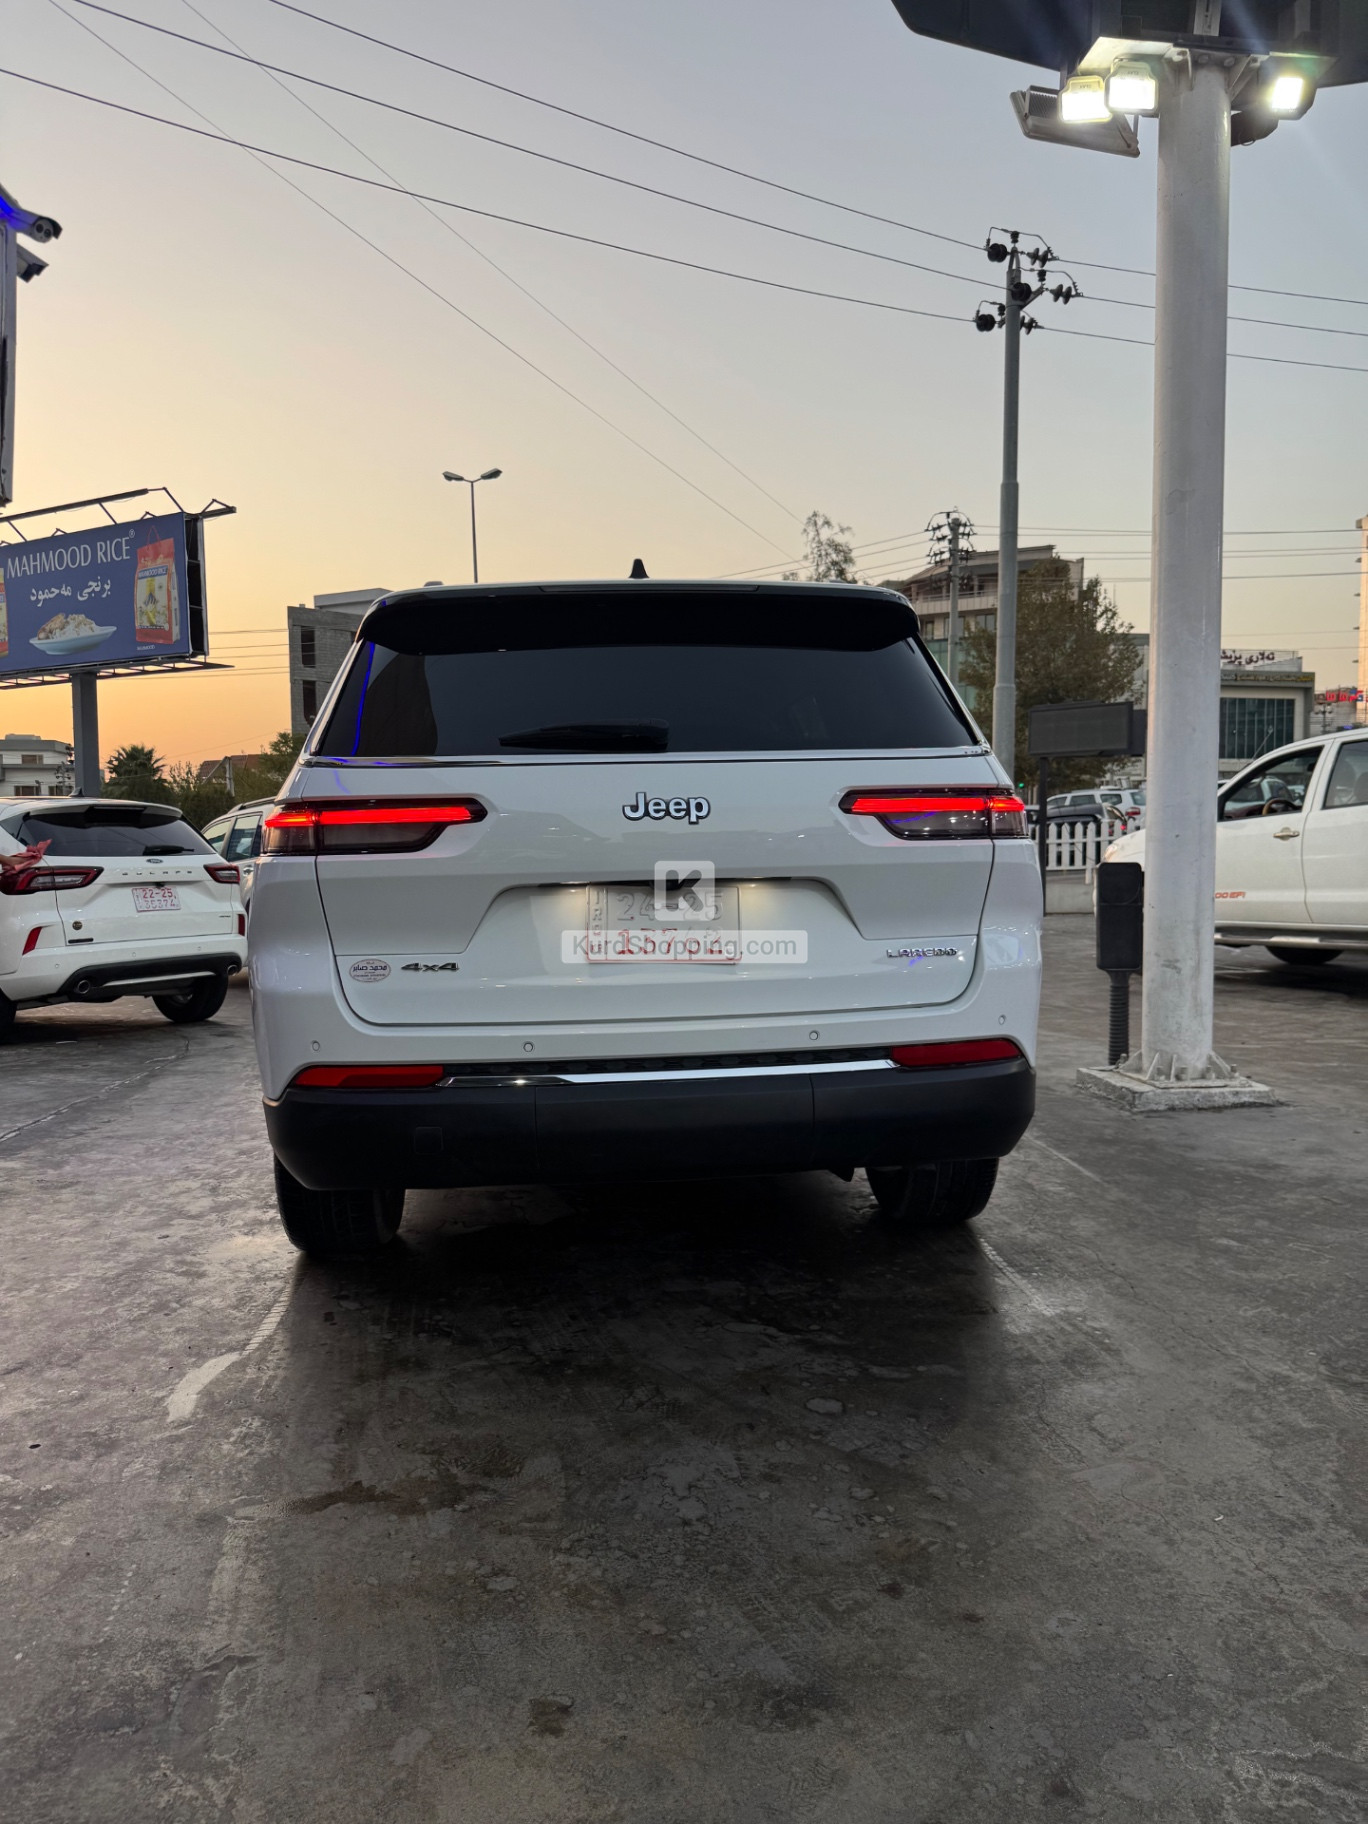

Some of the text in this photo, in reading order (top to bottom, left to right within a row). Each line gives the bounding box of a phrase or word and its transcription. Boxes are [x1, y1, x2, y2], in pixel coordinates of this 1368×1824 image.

[7, 546, 92, 579] MAHMOOD
[622, 791, 710, 825] Jeep
[401, 961, 460, 973] 4x4
